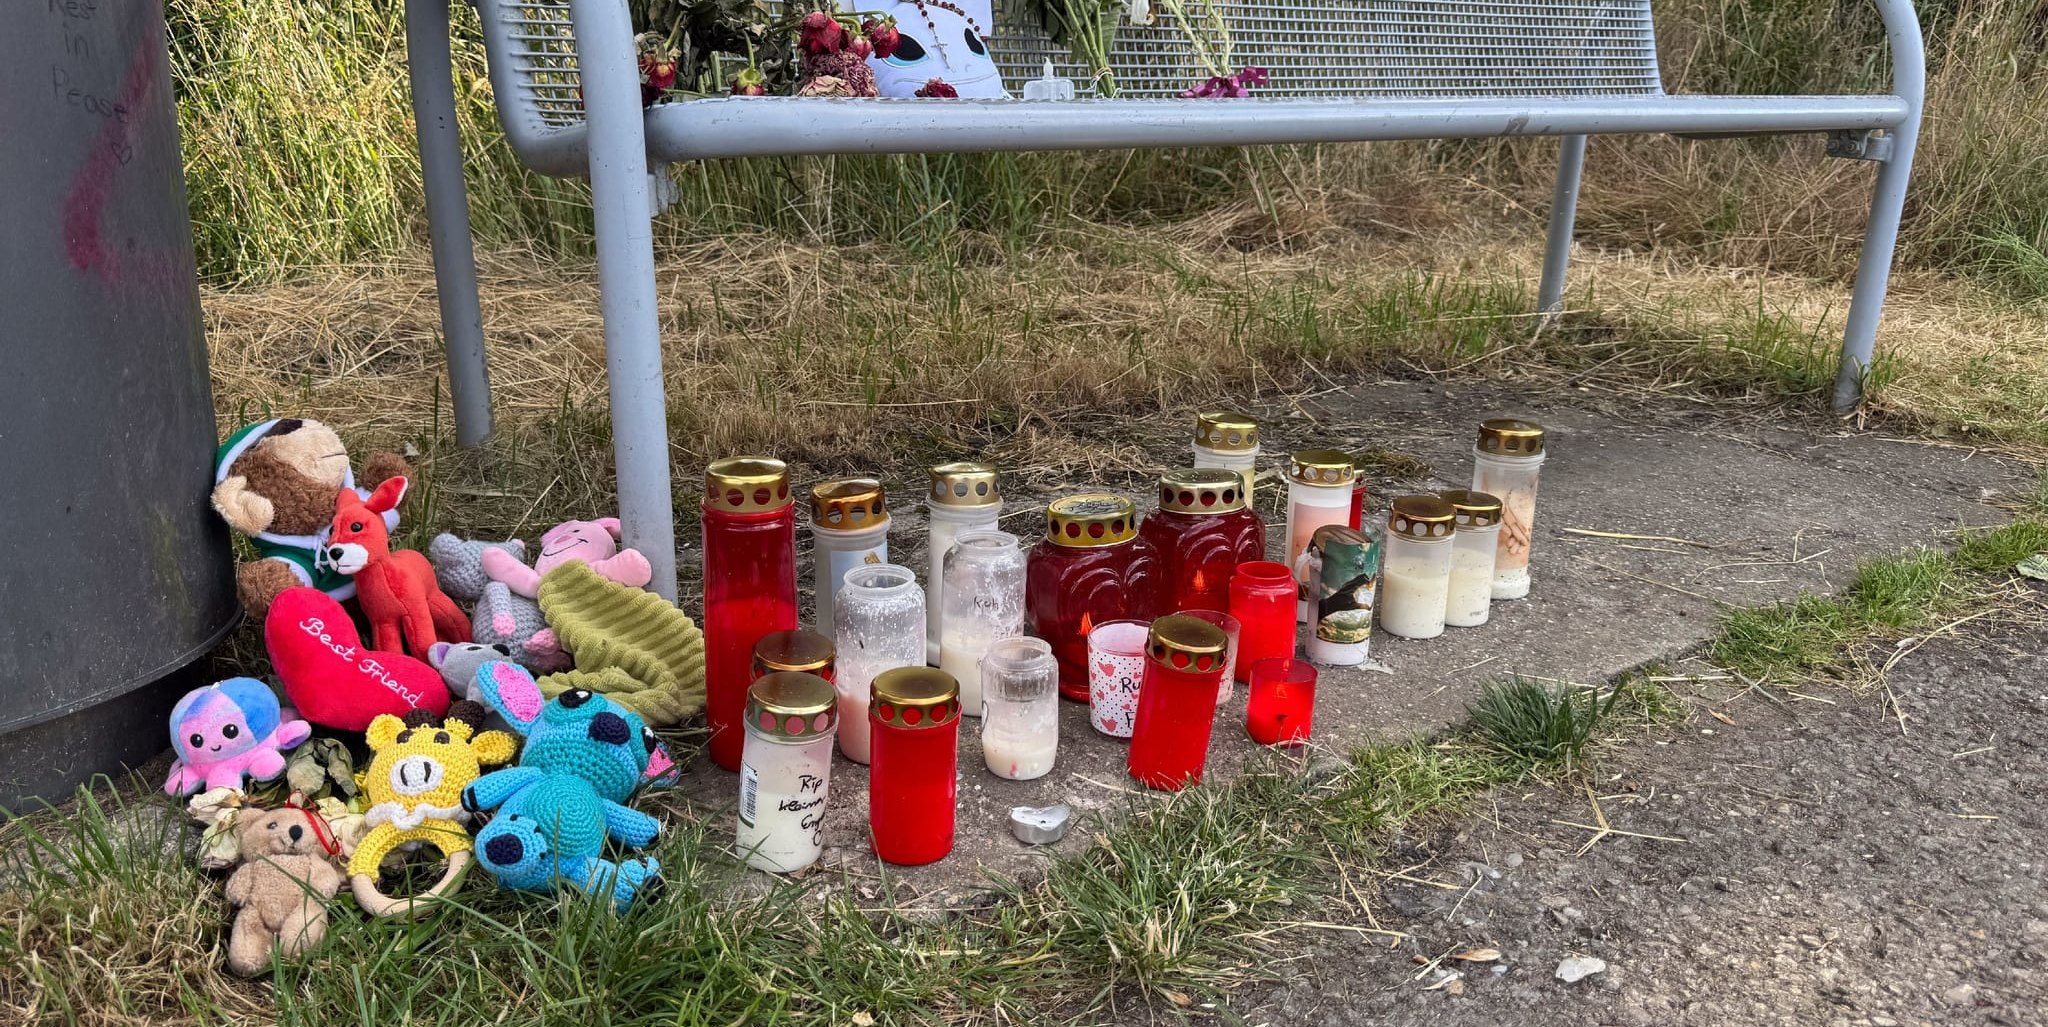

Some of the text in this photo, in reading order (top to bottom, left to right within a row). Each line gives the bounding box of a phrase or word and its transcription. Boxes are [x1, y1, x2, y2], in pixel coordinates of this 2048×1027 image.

[62, 21, 89, 59] in
[299, 617, 425, 708] Best Friend
[798, 774, 823, 794] Rip
